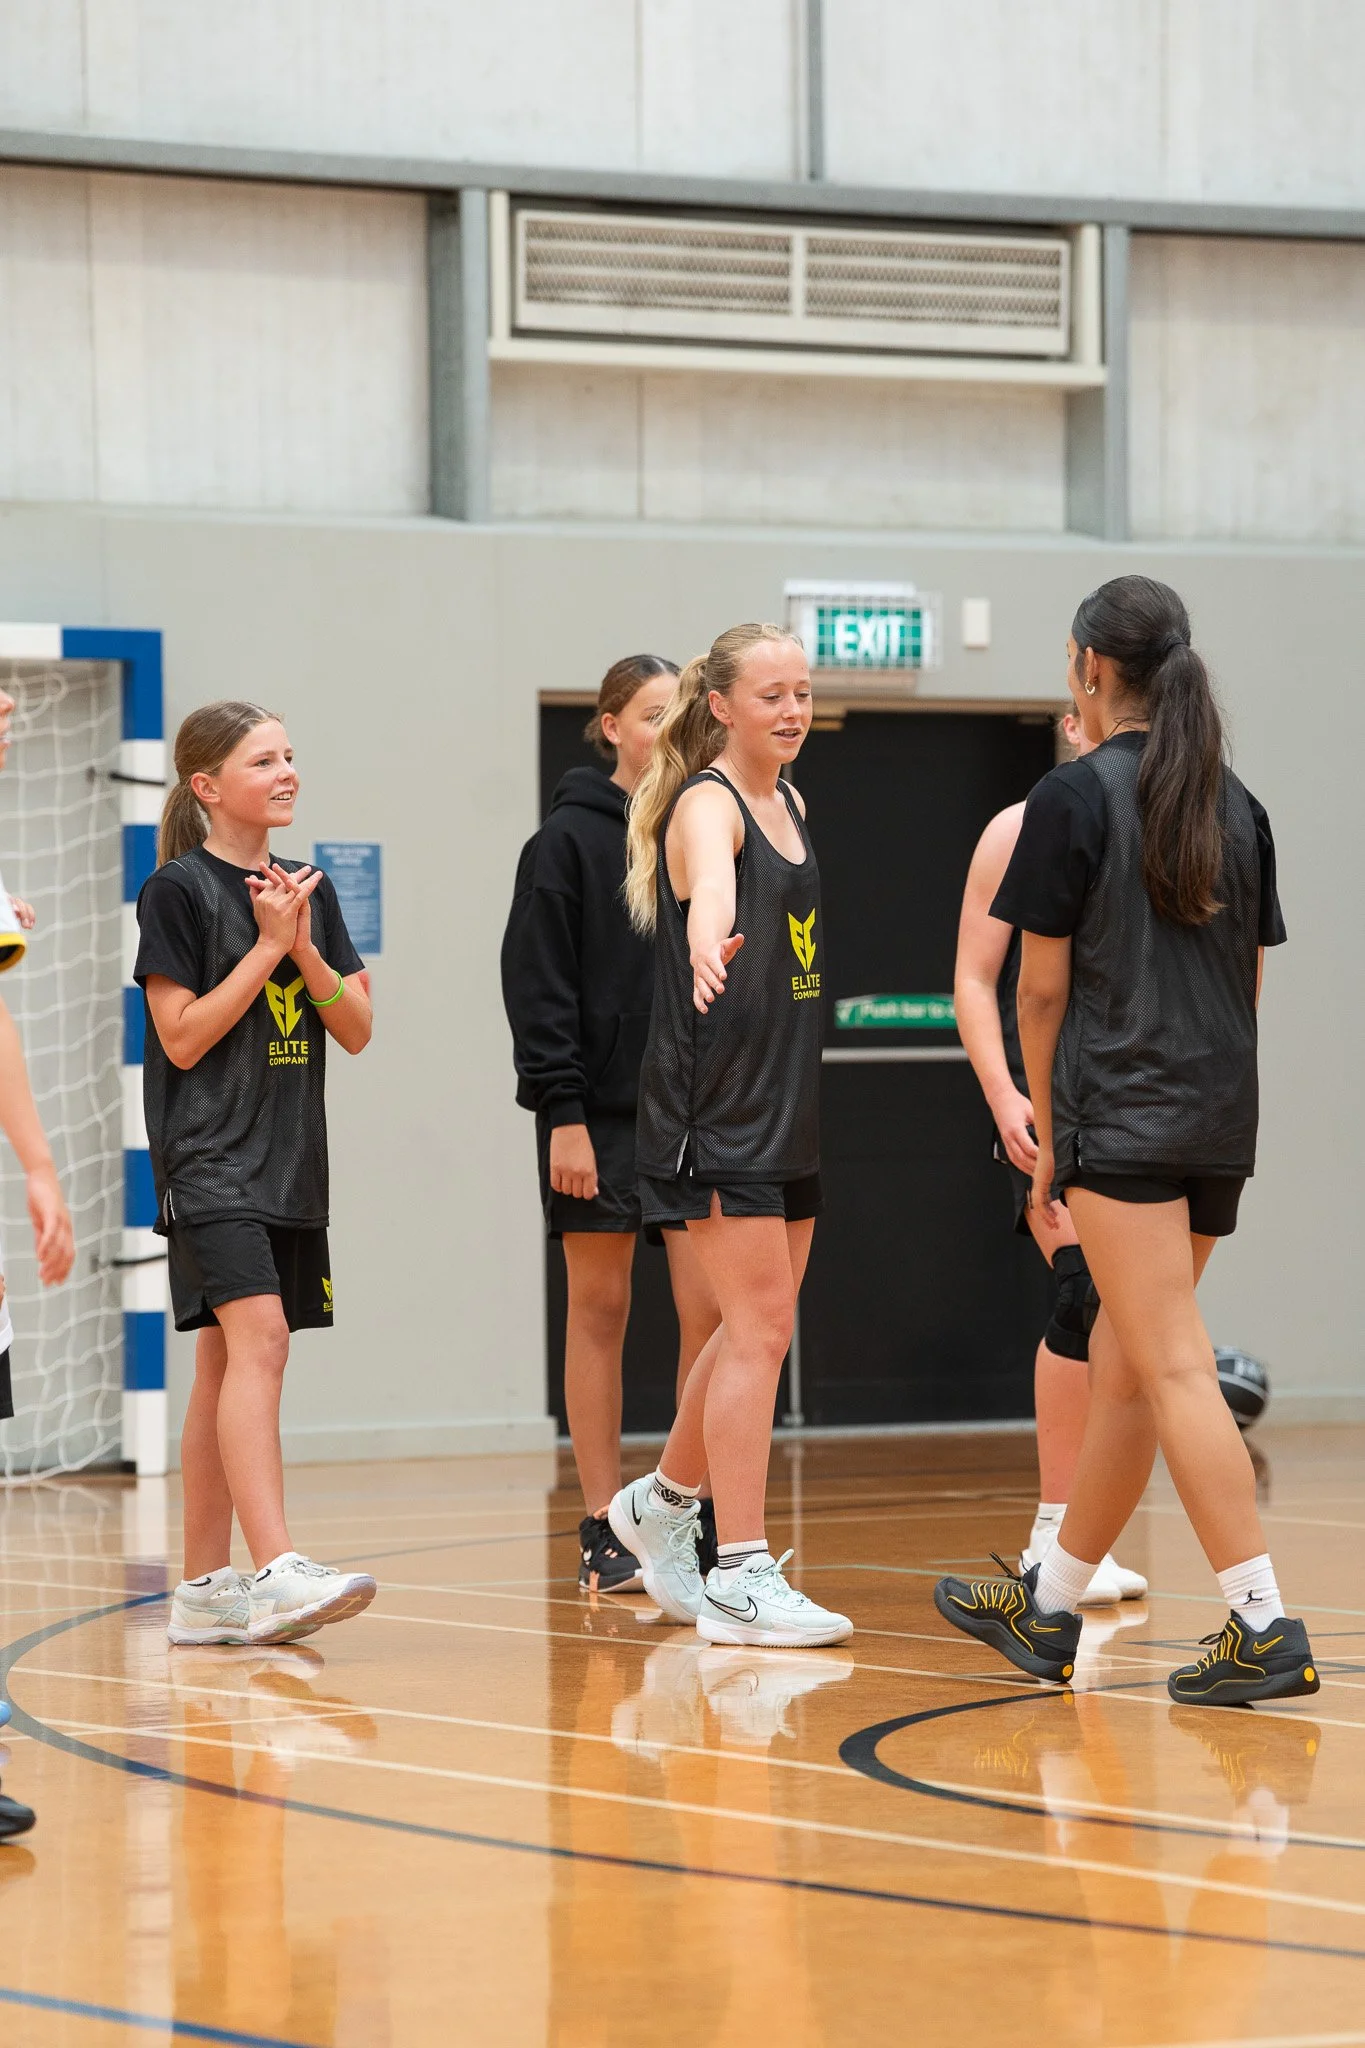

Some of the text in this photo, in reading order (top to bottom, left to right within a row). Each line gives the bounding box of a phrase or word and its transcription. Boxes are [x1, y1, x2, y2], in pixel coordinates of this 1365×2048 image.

[834, 613, 904, 660] EXIT
[791, 974, 820, 991] ELITE
[793, 990, 820, 1001] COMPANY
[269, 1041, 308, 1055] ELITE
[269, 1057, 309, 1066] COMPANY
